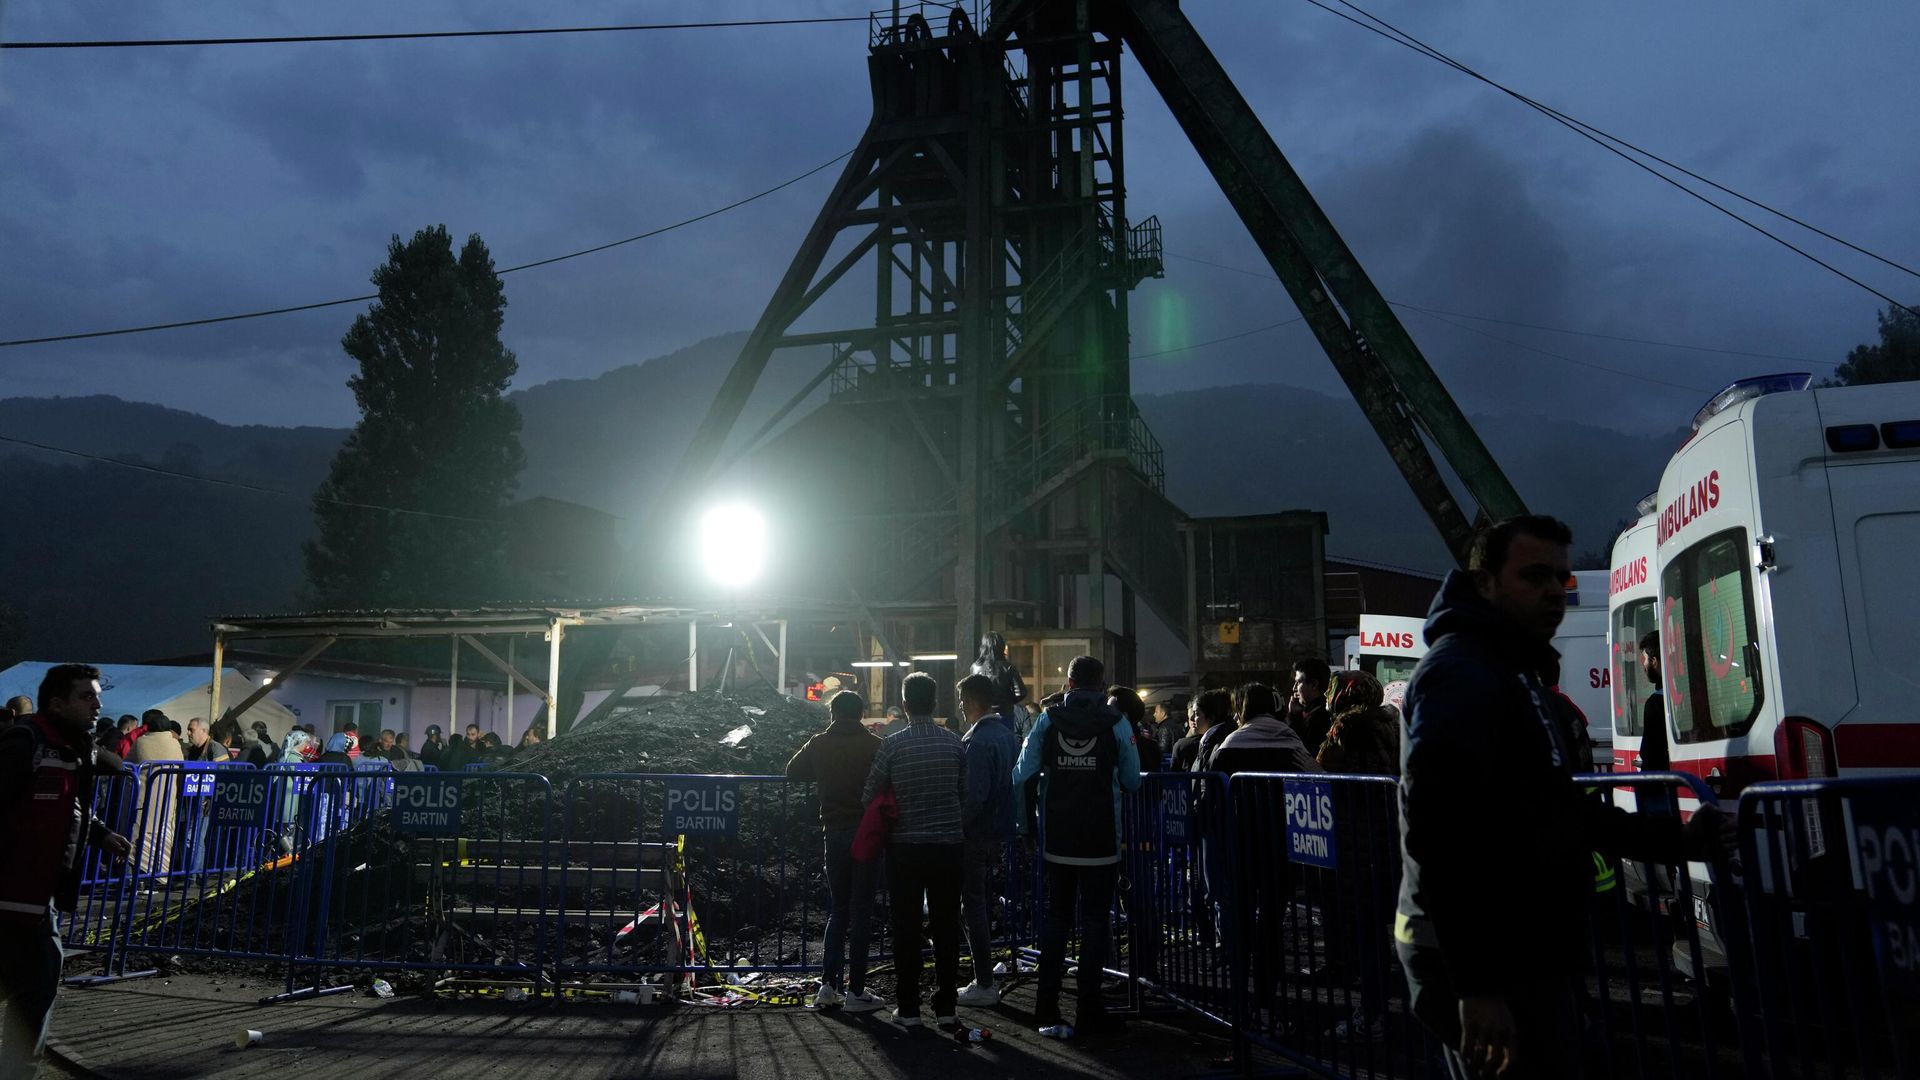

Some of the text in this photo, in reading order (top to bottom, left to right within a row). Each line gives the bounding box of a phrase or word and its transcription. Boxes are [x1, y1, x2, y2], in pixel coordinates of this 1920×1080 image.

[1657, 470, 1720, 549] AMBULANS
[1360, 632, 1414, 649] LANS
[1057, 755, 1097, 767] UMKE
[214, 778, 264, 805] POLİS
[396, 780, 458, 808] POLİS
[667, 785, 736, 812] POLİS
[218, 807, 255, 821] BARTIN
[402, 811, 448, 826] BARTIN
[1284, 786, 1334, 831] POLİS
[675, 816, 726, 830] BARTIN
[1292, 832, 1328, 857] BARTIN
